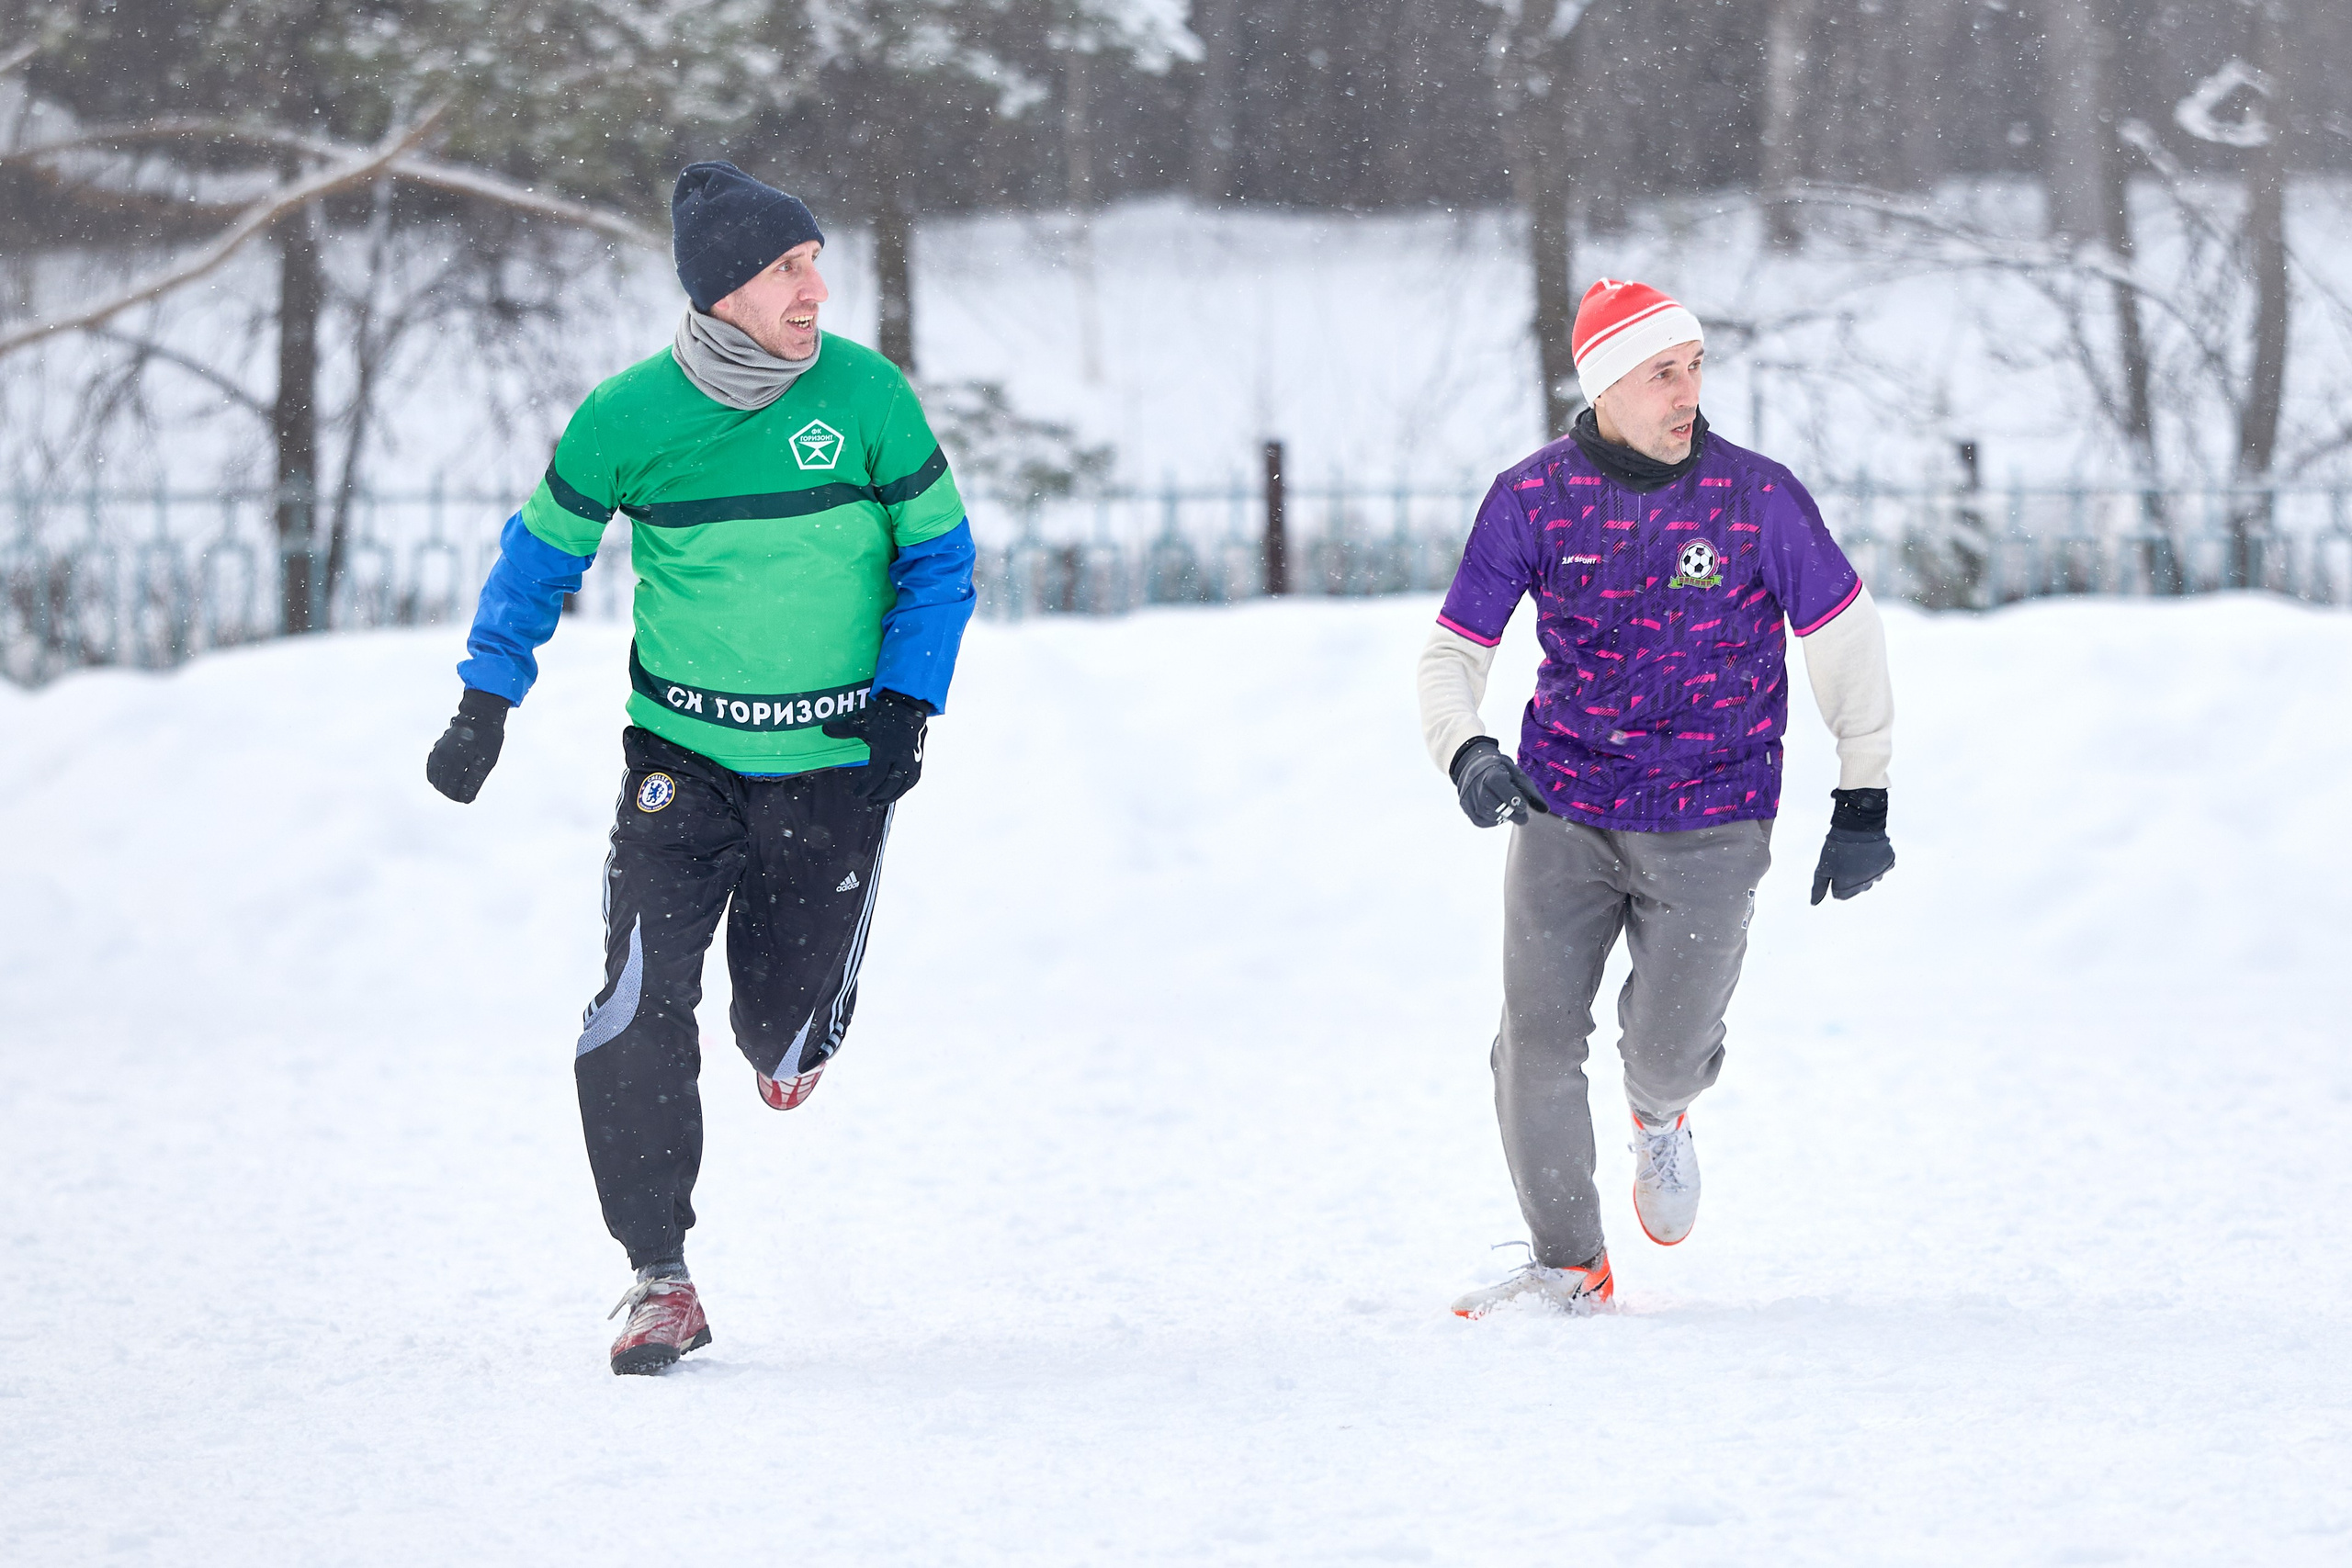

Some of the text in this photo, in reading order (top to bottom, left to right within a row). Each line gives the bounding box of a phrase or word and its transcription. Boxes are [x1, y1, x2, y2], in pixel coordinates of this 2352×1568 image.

[1562, 556, 1597, 565] 2K SPORT
[667, 686, 871, 727] СК ГОРИЗОНТ
[647, 774, 670, 785] CHELSEA
